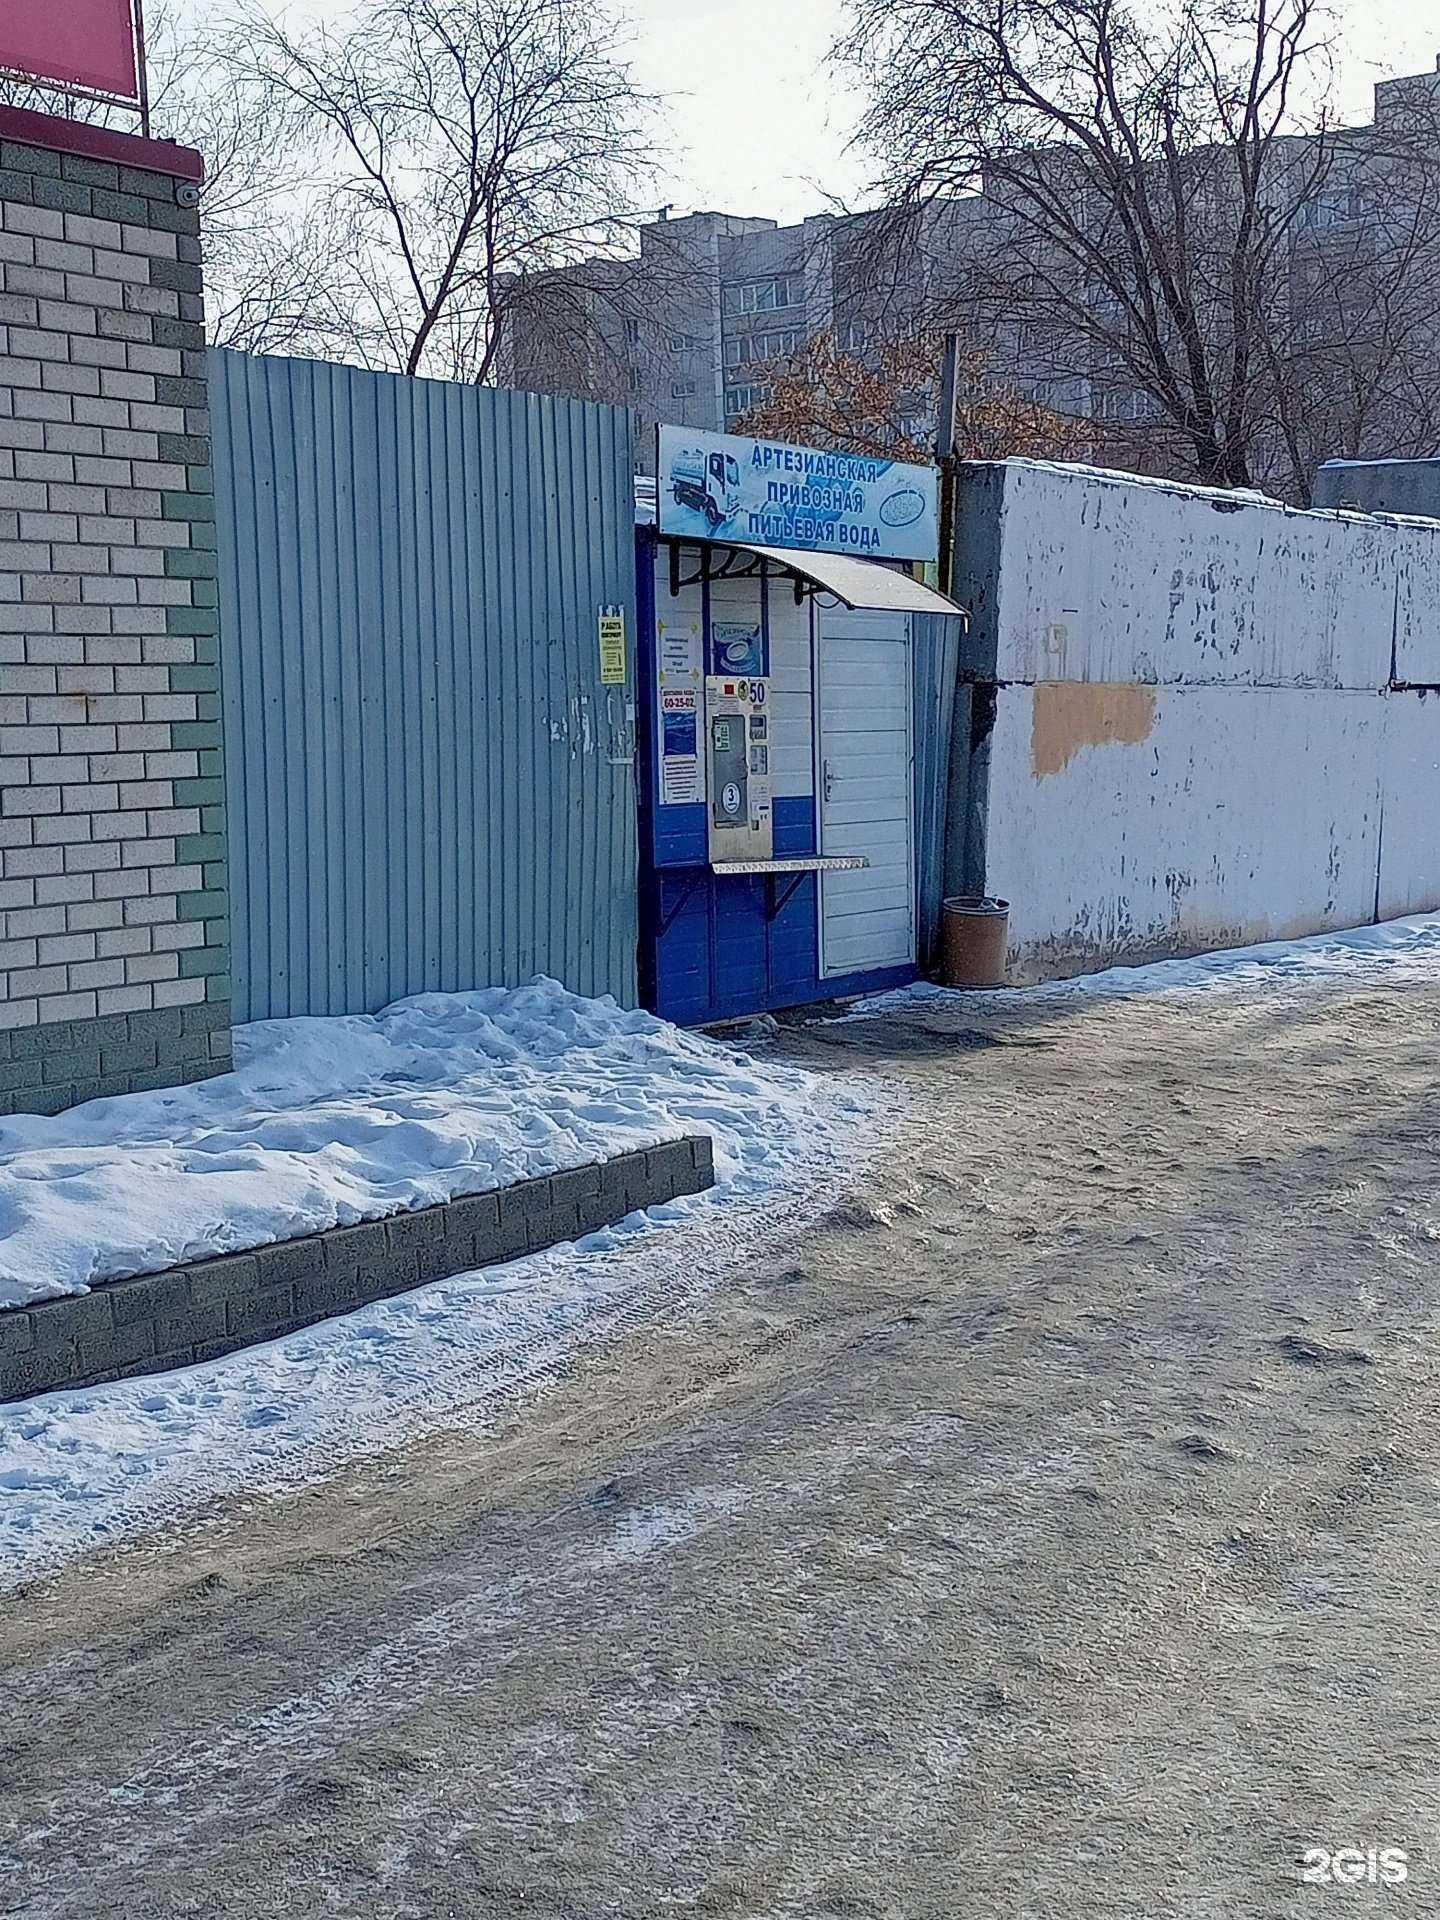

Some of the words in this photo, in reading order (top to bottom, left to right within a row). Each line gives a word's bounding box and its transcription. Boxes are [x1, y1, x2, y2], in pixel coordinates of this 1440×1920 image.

[751, 445, 877, 483] АРТЕЗИАНСКАЯ
[767, 481, 863, 513] ПРИВОЗНАЯ
[748, 513, 835, 542] ПИТЬЕВАЯ
[839, 526, 881, 549] ВОДА
[749, 682, 765, 703] 50
[728, 788, 735, 802] 3
